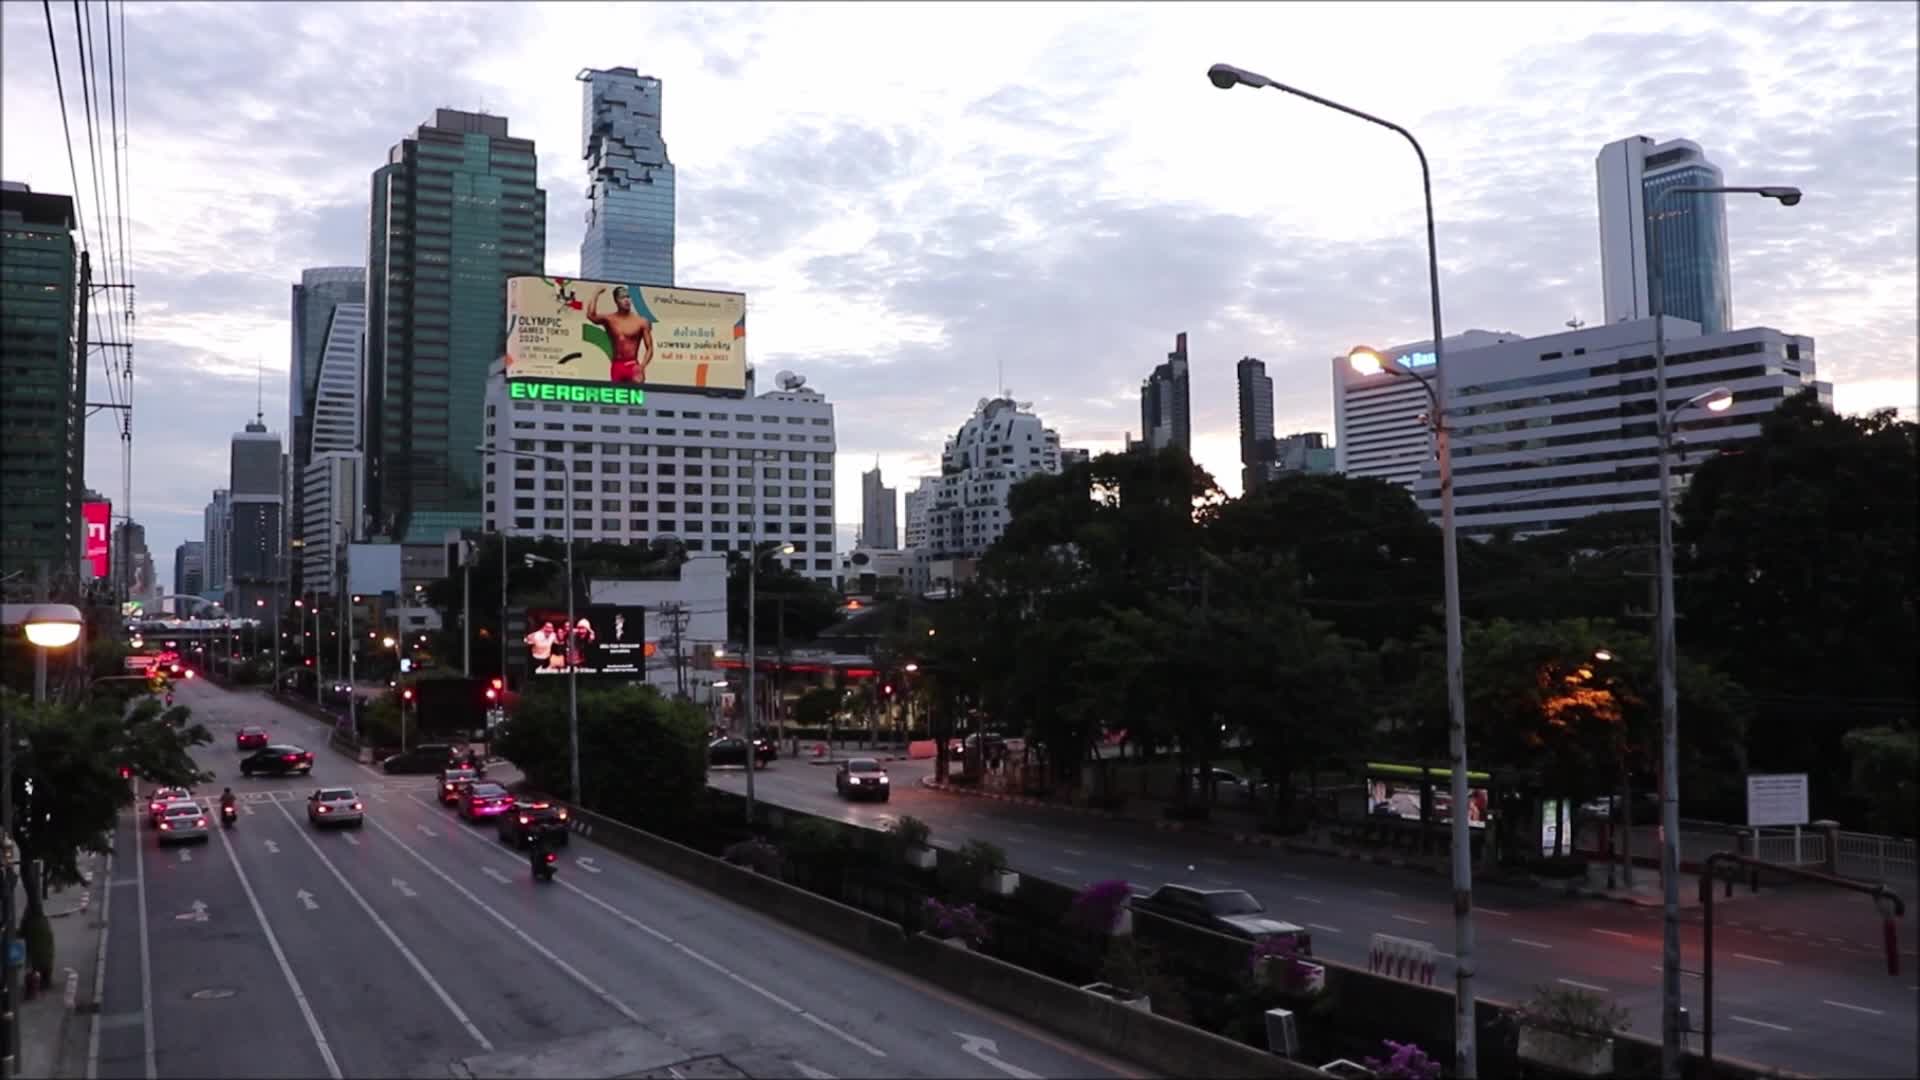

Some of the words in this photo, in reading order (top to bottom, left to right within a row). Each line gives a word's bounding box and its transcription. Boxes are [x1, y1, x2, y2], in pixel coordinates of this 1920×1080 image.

[518, 316, 562, 328] OLYMPIC
[518, 327, 544, 335] GAMES
[546, 328, 570, 337] TOKYO
[511, 382, 645, 405] EVERGREEN
